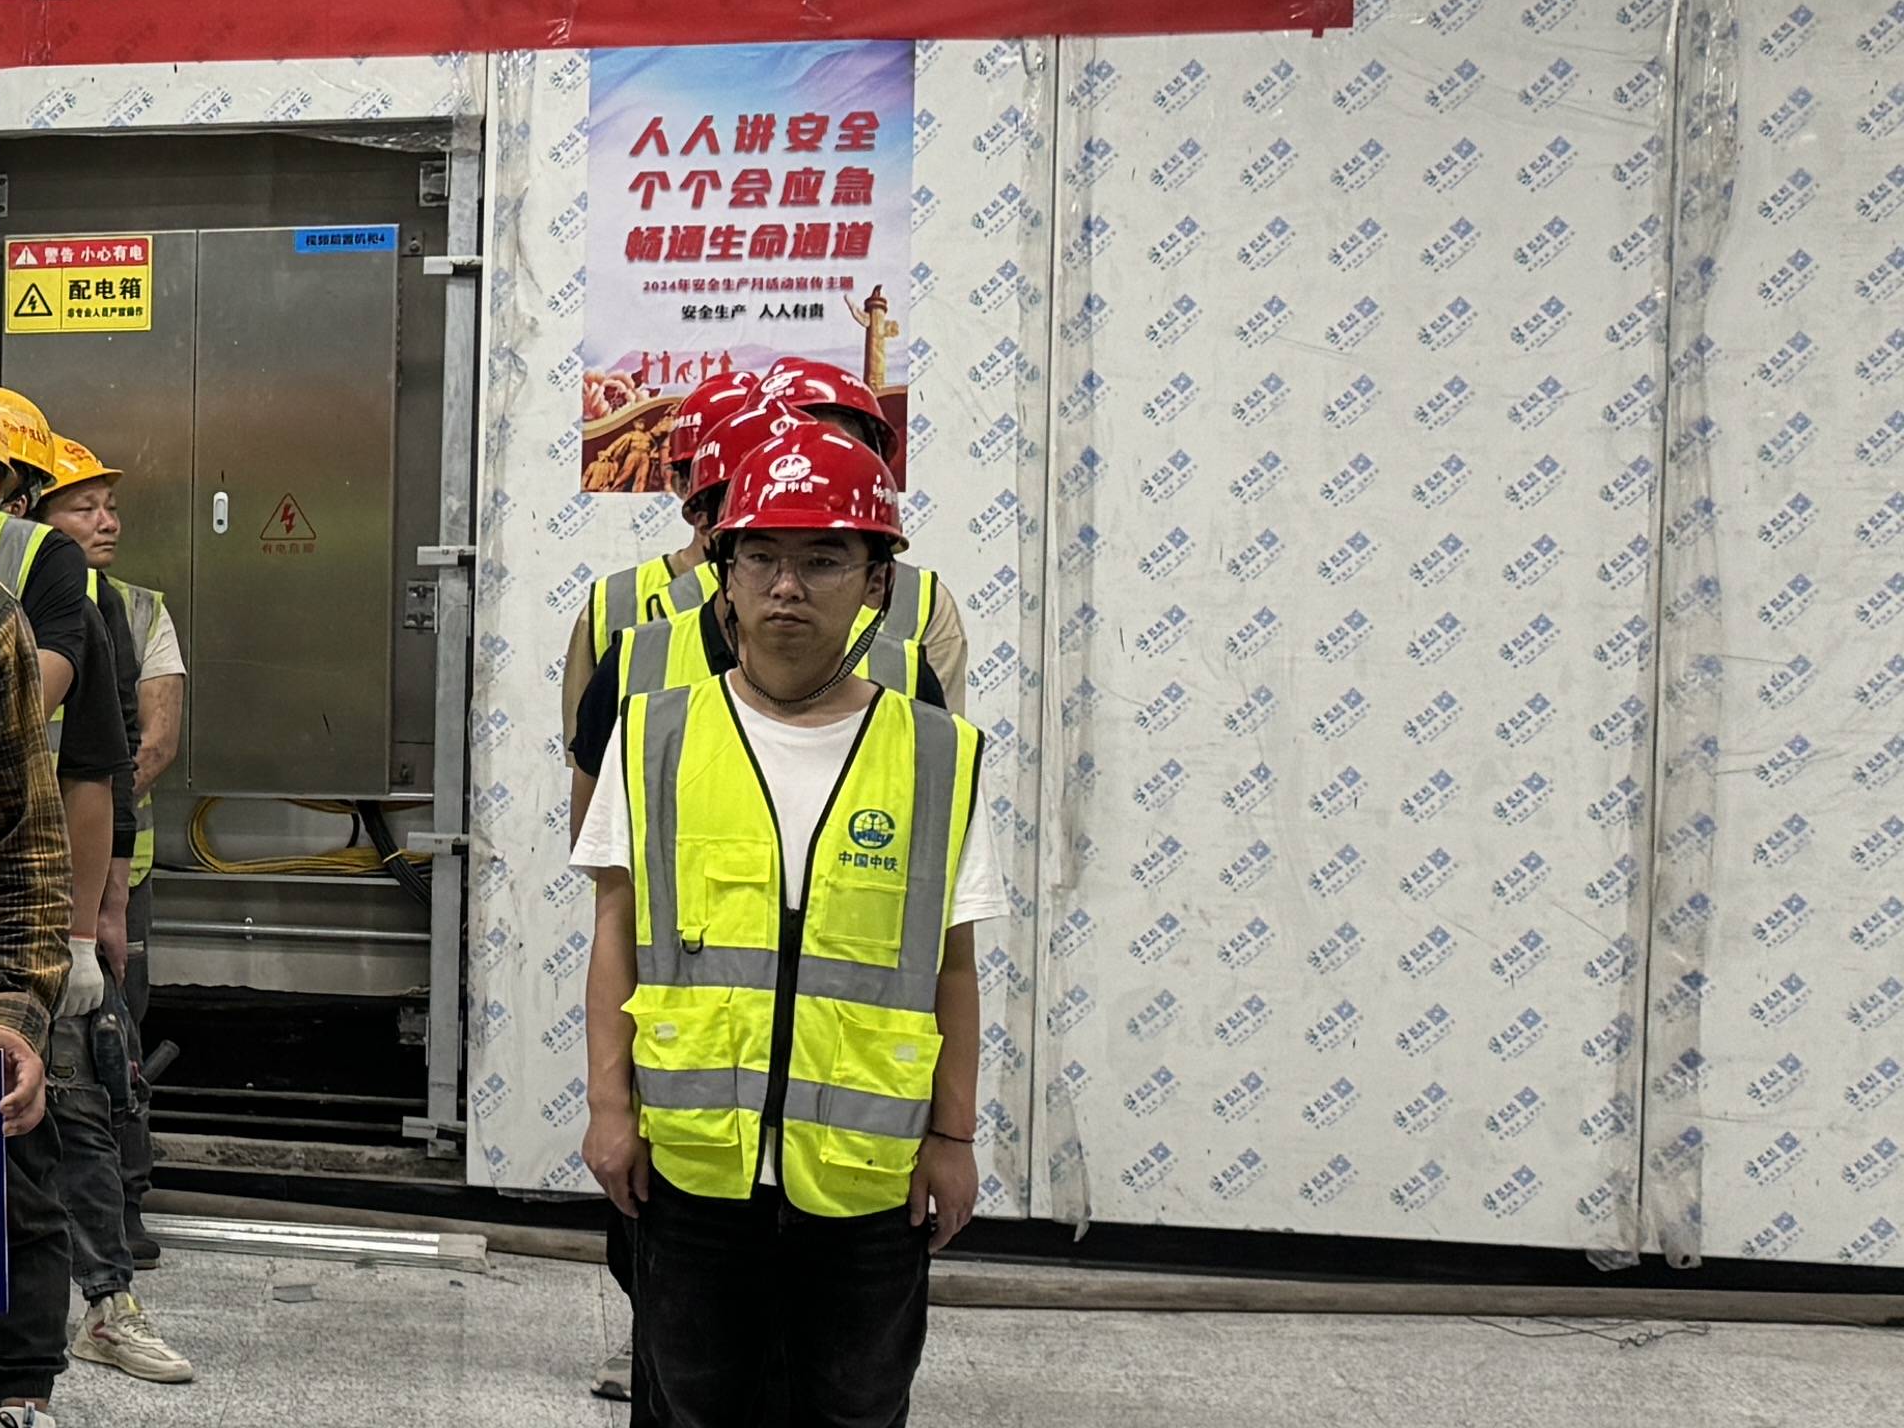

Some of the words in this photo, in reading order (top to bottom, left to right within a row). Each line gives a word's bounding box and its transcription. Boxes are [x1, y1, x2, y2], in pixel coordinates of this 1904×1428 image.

[628, 110, 880, 157] 人人讲安全
[628, 166, 876, 210] 个个会应急
[624, 221, 875, 263] 畅通生命通道
[44, 247, 75, 264] 警告
[80, 244, 145, 262] 小心有电
[68, 278, 142, 300] 配电箱
[682, 304, 746, 320] 安全生产
[759, 303, 824, 320] 人人有责
[838, 850, 898, 872] 中国中铁
